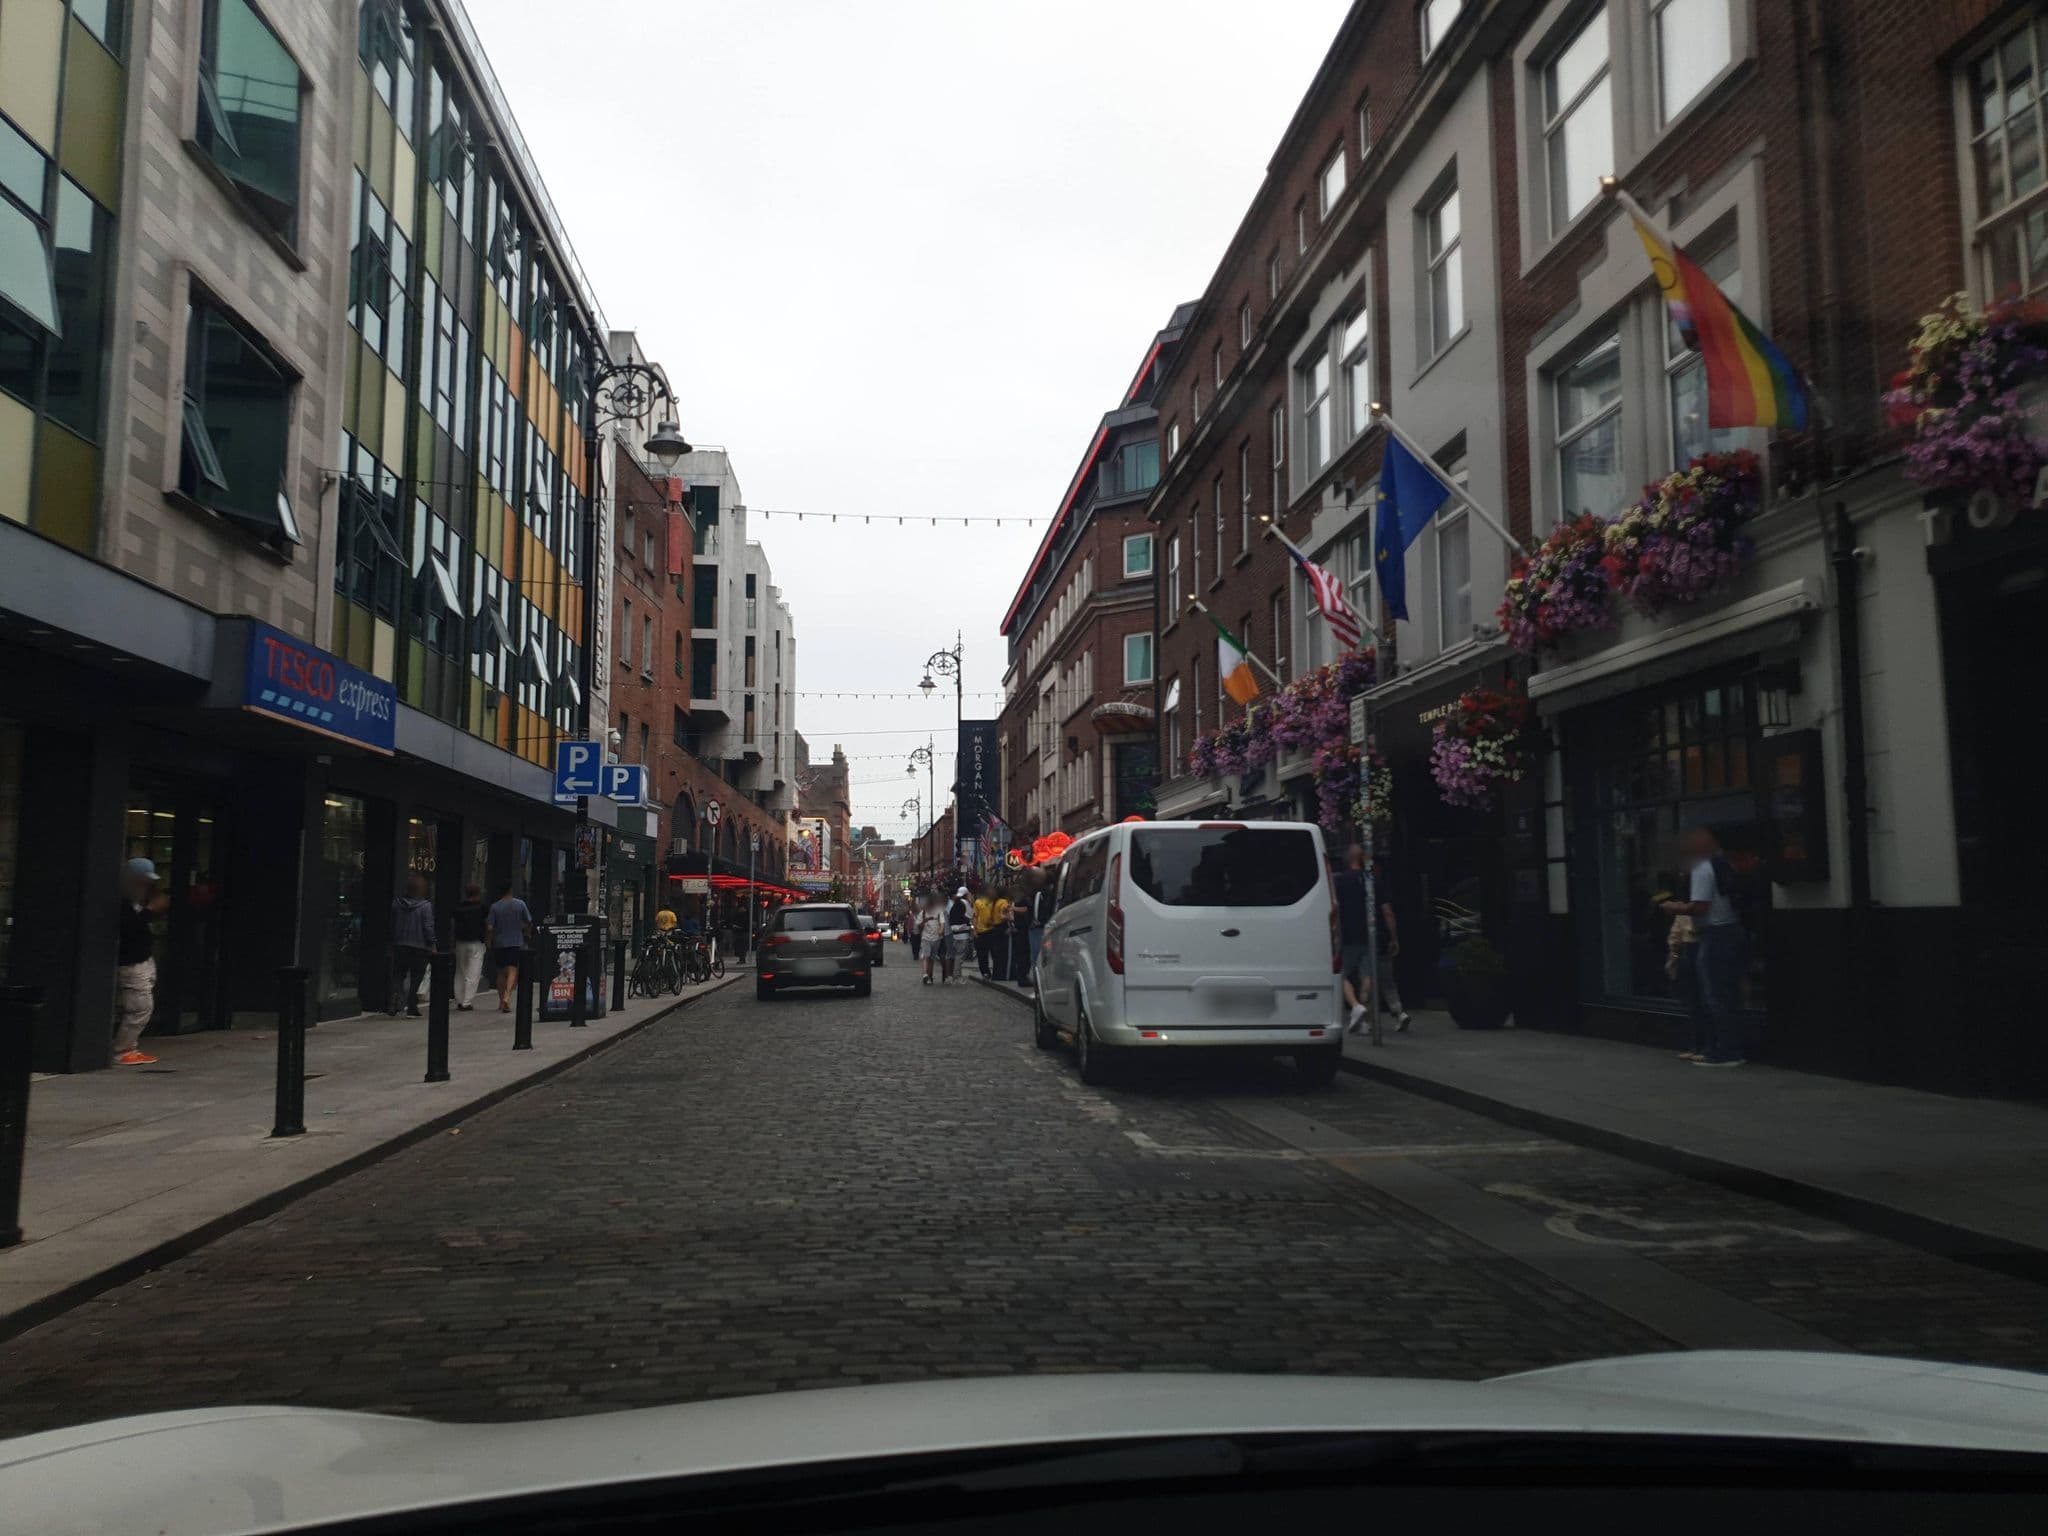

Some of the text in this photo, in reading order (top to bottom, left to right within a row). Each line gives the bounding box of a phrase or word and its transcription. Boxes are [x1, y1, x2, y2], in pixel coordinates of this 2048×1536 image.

[264, 636, 391, 721] TESCO express
[569, 746, 589, 773] P
[974, 735, 983, 790] MORGAN
[612, 767, 630, 792] P
[554, 988, 571, 997] BIN
